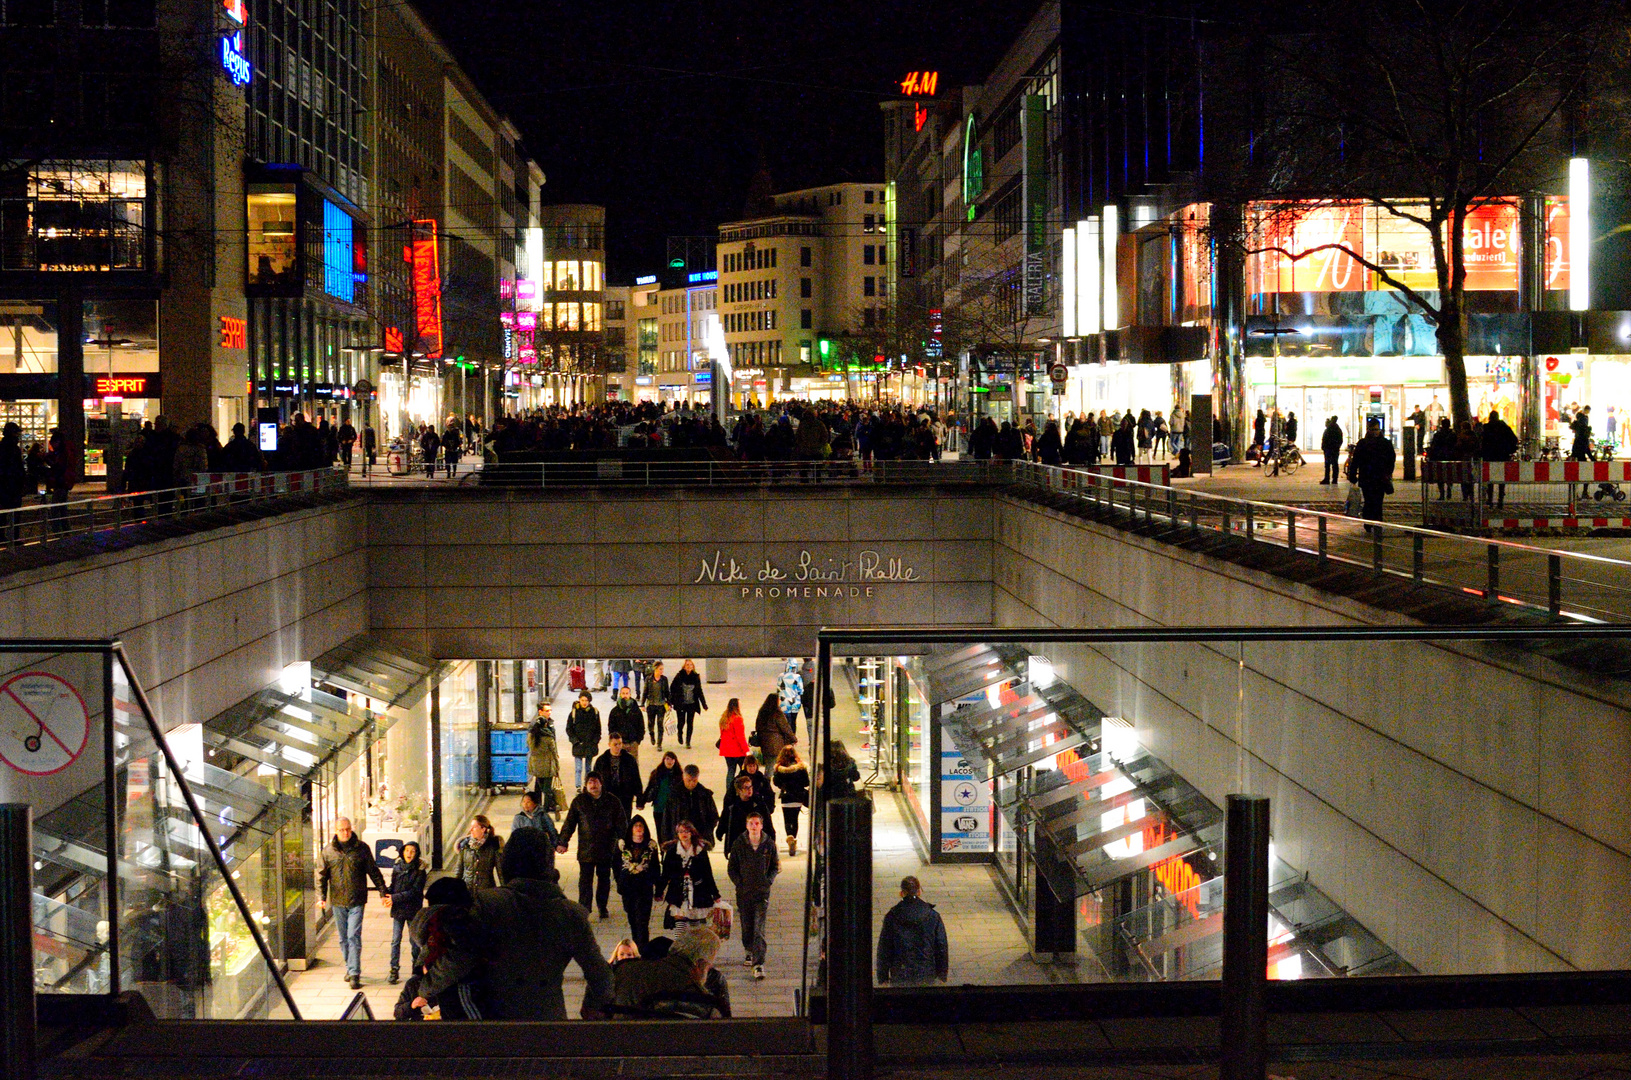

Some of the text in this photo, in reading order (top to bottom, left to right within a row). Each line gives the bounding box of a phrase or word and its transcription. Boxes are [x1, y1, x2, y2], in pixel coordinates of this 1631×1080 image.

[223, 36, 250, 85] Regus
[900, 71, 938, 96] H&M
[1463, 252, 1506, 263] eduziert]
[1028, 251, 1043, 304] GALERIA
[221, 315, 247, 349] ESPRIT
[503, 328, 512, 358] MANGO
[97, 379, 146, 392] ESPRIT
[695, 550, 921, 583] Niki de Saint Phalle
[741, 587, 874, 598] PROMENADE
[957, 817, 976, 831] VANS
